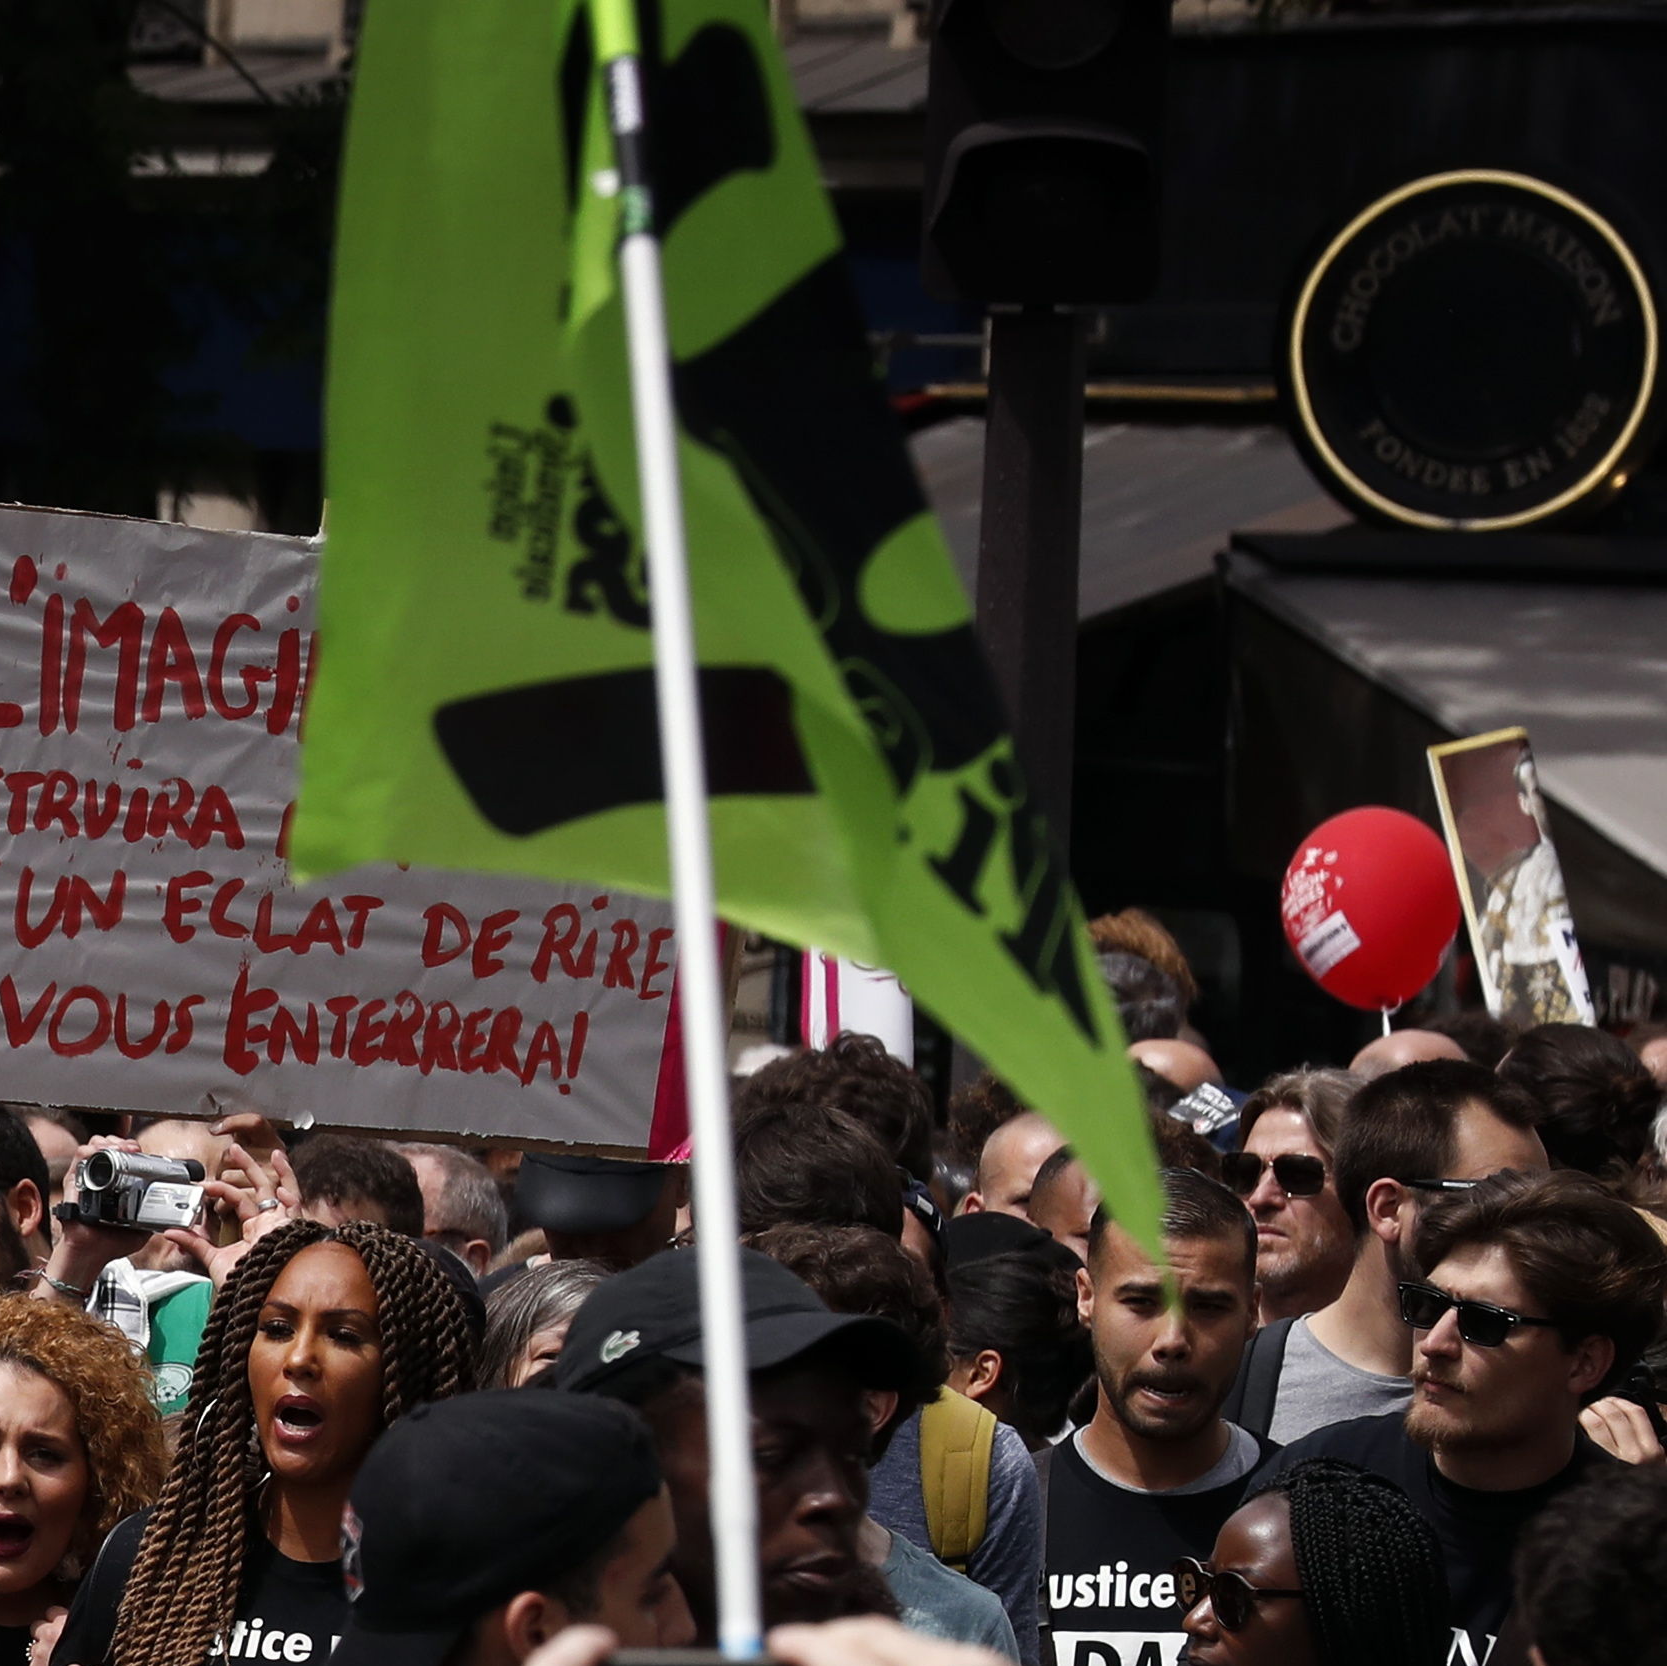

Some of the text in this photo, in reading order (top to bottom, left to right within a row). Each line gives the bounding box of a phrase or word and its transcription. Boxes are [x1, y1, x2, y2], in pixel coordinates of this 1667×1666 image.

[14, 867, 126, 950] UN
[420, 901, 523, 981] DE
[221, 967, 590, 1096] ENTERRERA!
[1049, 1560, 1177, 1609] ustice
